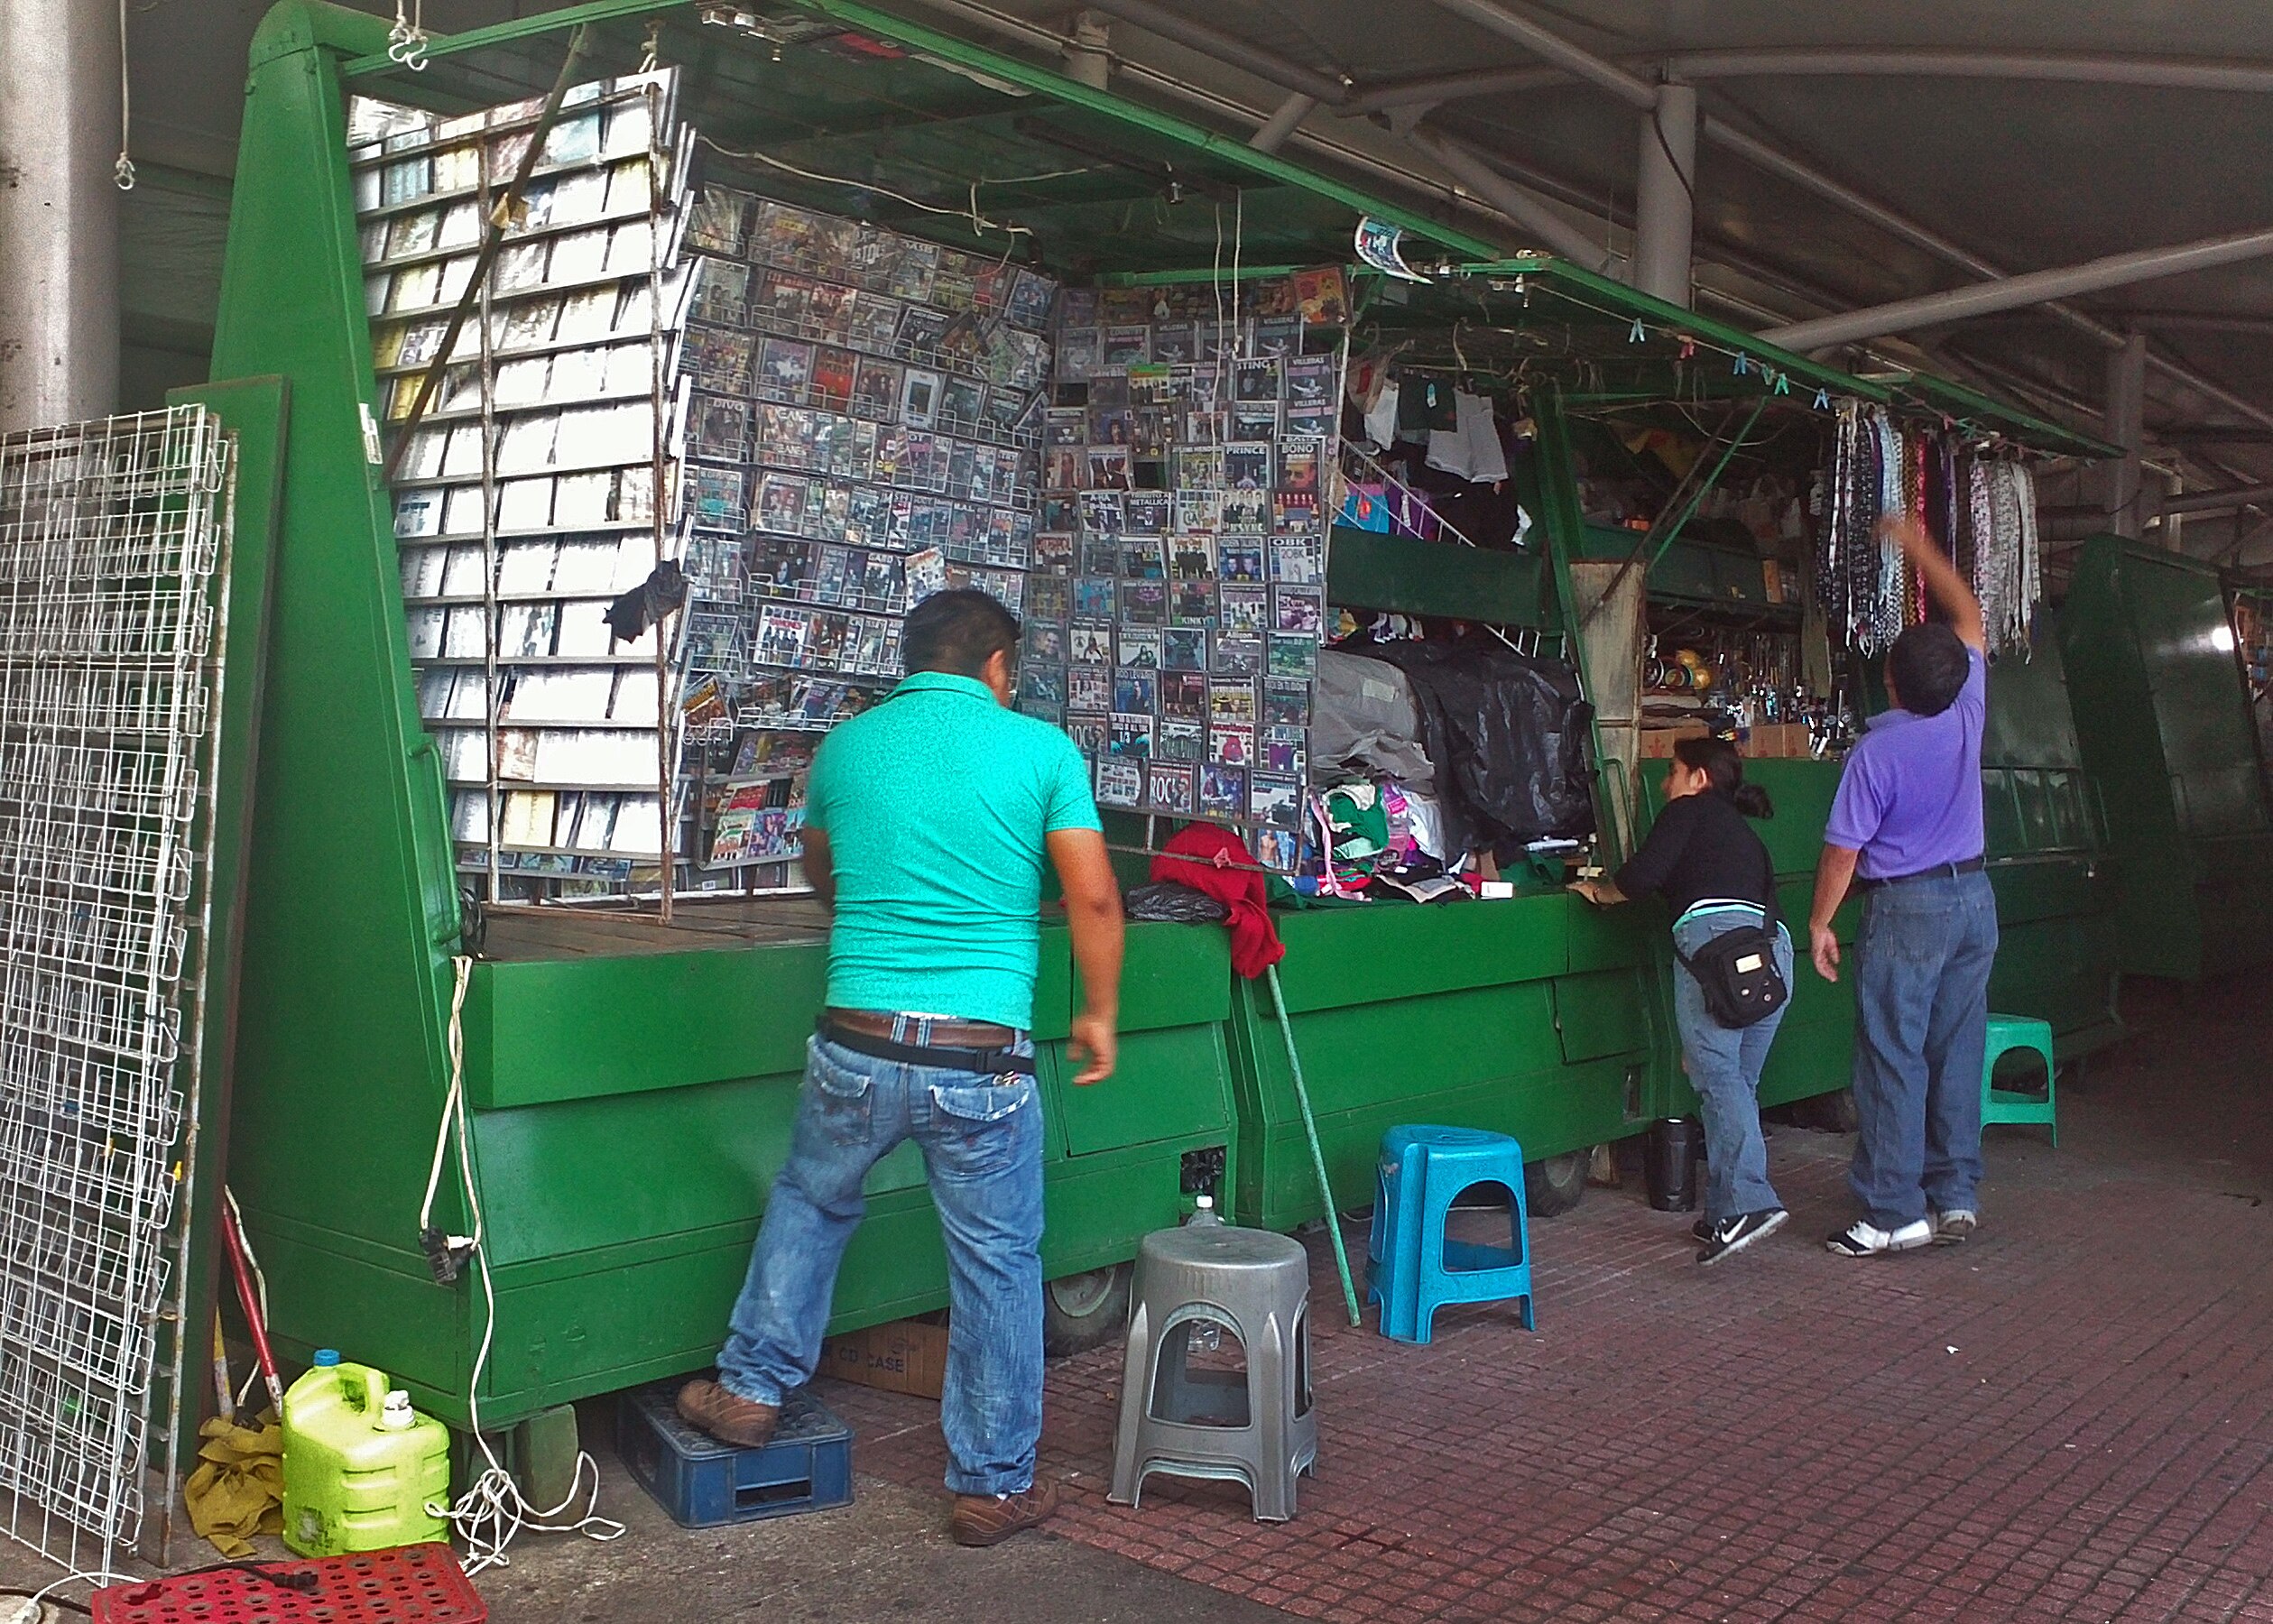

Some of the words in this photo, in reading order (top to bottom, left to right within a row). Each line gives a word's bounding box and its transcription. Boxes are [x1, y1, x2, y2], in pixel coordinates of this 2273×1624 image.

[1236, 360, 1270, 372] STING
[1225, 445, 1265, 456] PRINCE
[1281, 443, 1315, 454] BONO
[1272, 538, 1307, 546] OBK
[1181, 616, 1206, 625] KINKY
[866, 1355, 903, 1373] CASE
